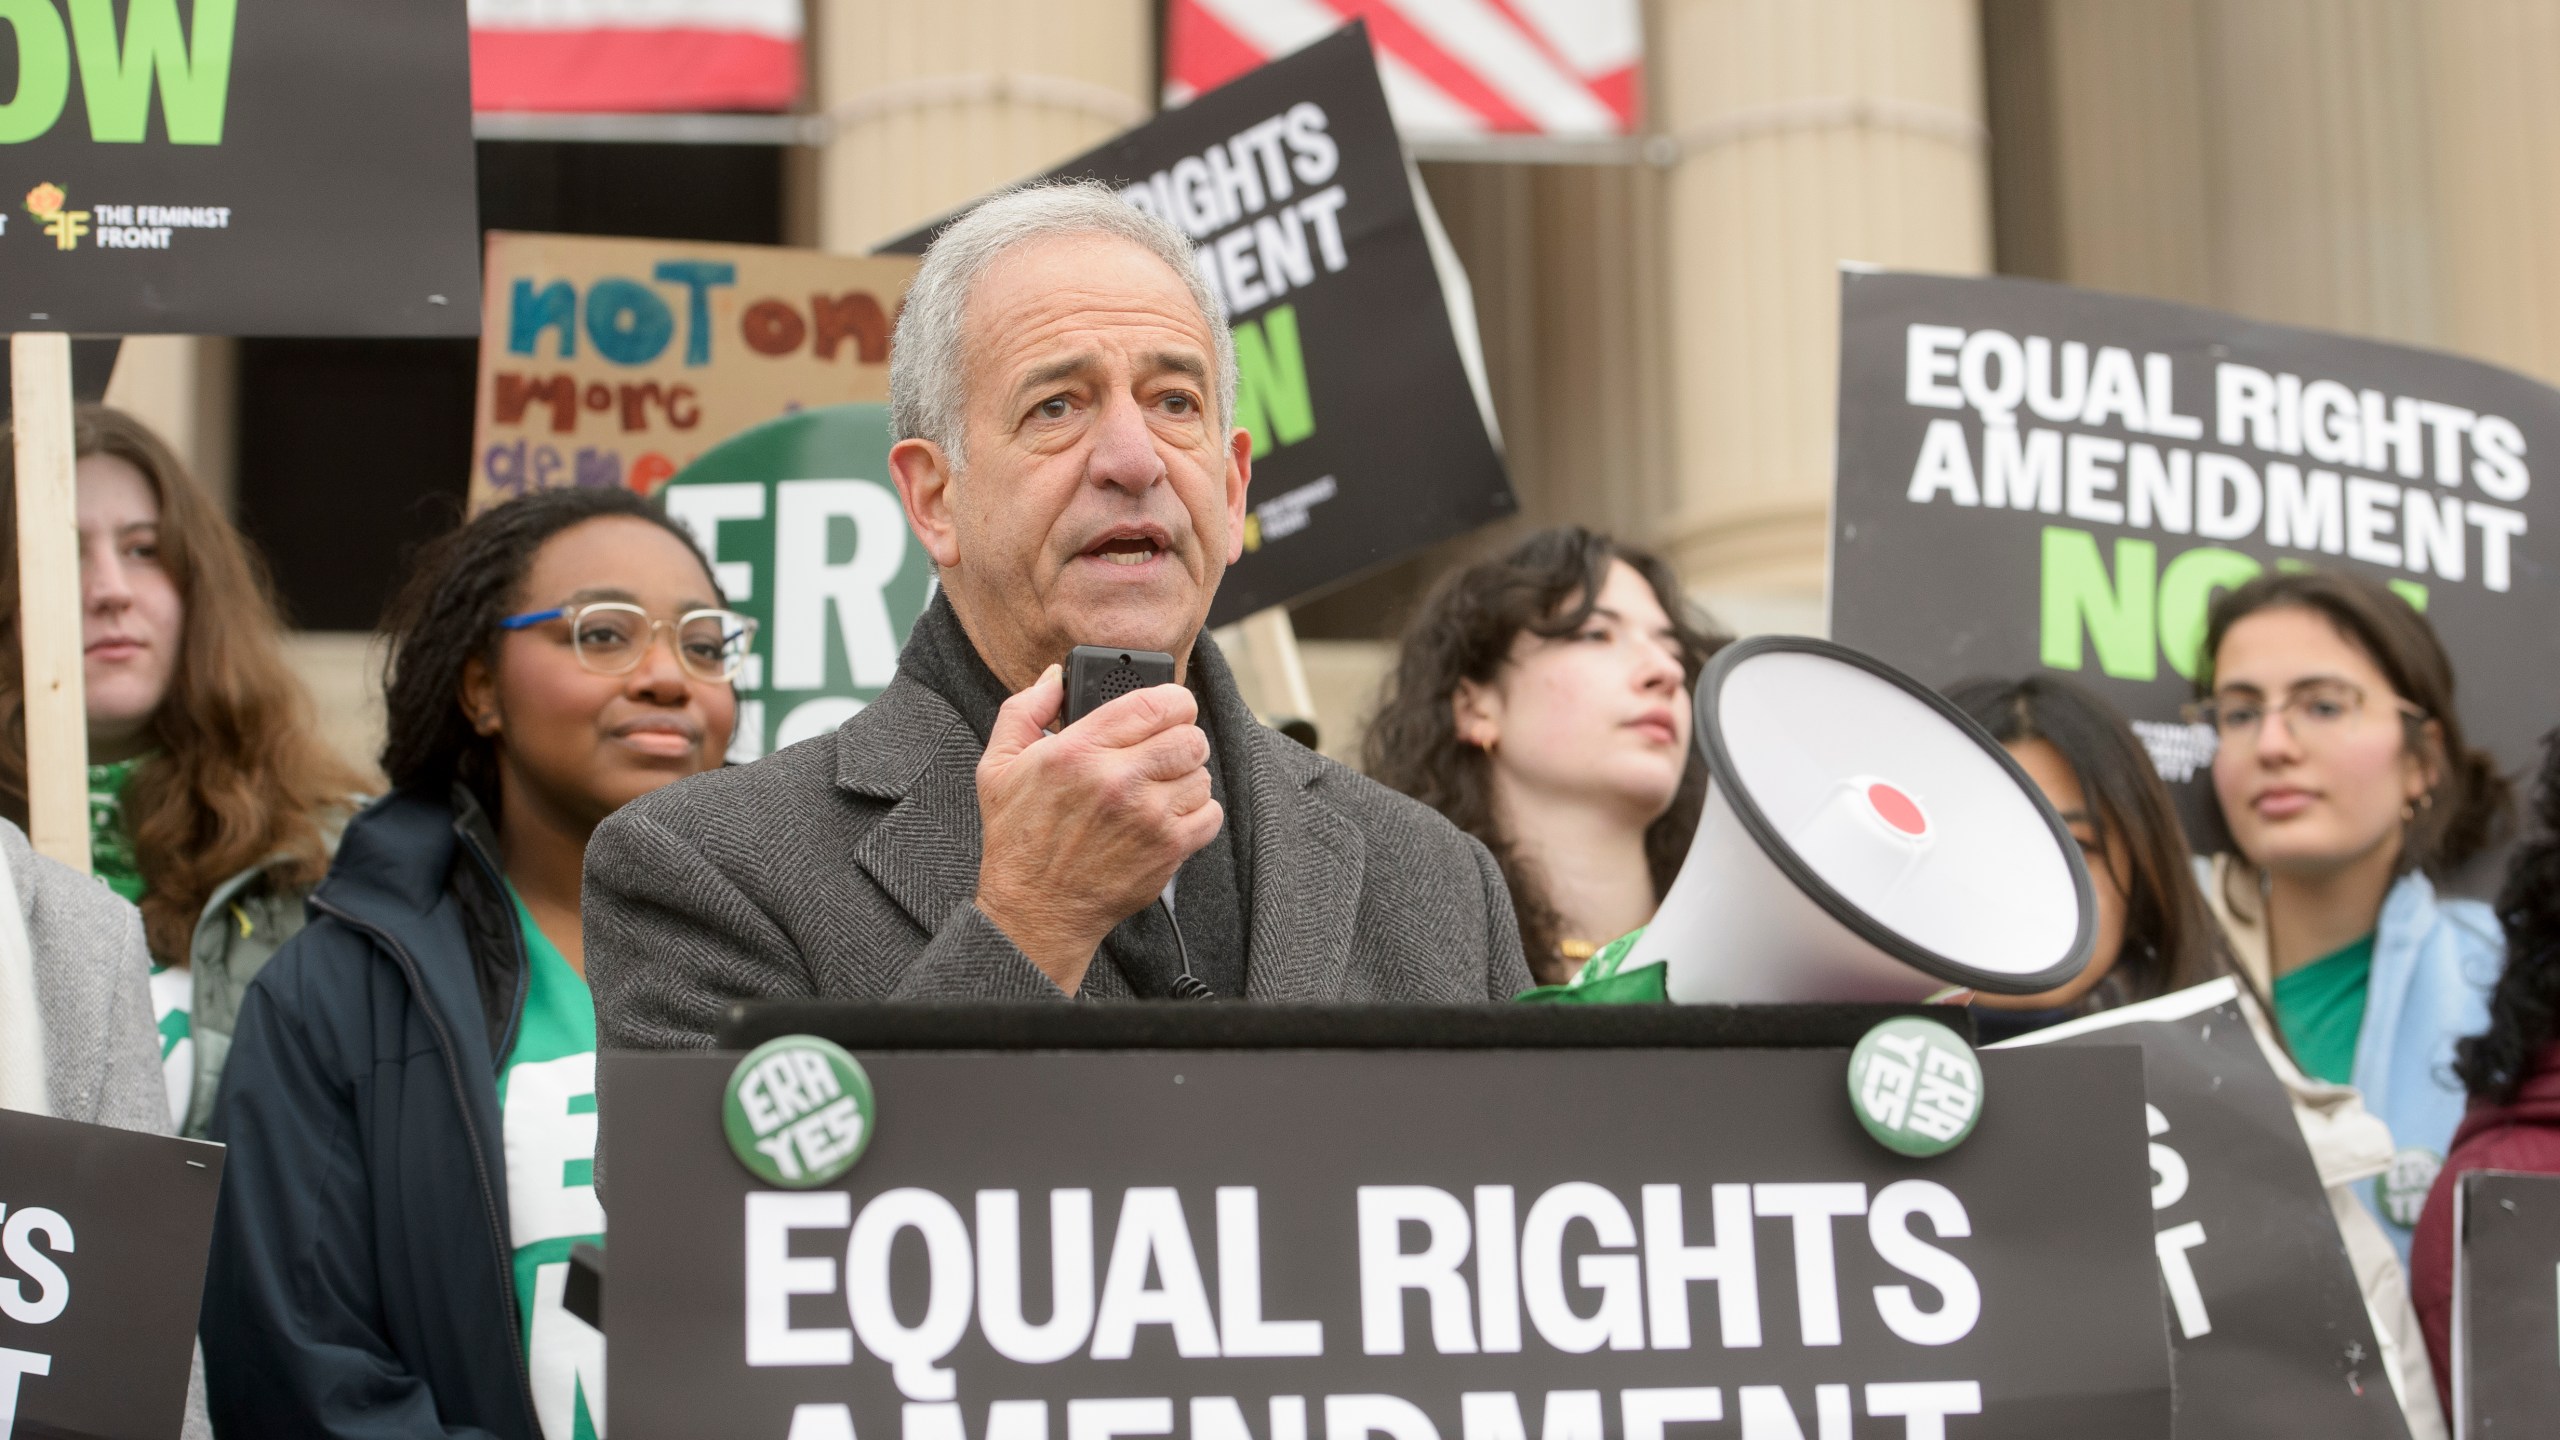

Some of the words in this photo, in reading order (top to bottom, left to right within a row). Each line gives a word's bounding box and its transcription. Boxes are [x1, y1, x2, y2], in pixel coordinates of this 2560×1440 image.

[94, 204, 135, 225] THE
[136, 205, 231, 228] FEMINIST
[95, 226, 173, 249] FRONT
[741, 285, 900, 365] on
[1906, 322, 2203, 440] EQUAL
[2215, 361, 2531, 501] RIGHTS
[1907, 418, 2528, 593] AMENDMENT
[664, 478, 938, 691] ER
[2040, 525, 2429, 684] NO
[738, 1050, 842, 1136] ERA
[1861, 1032, 1926, 1133] YES
[1908, 1045, 1977, 1143] ERA
[756, 1095, 865, 1180] YES
[745, 1187, 1324, 1401] EQUAL
[1357, 1179, 1981, 1355] RIGHTS
